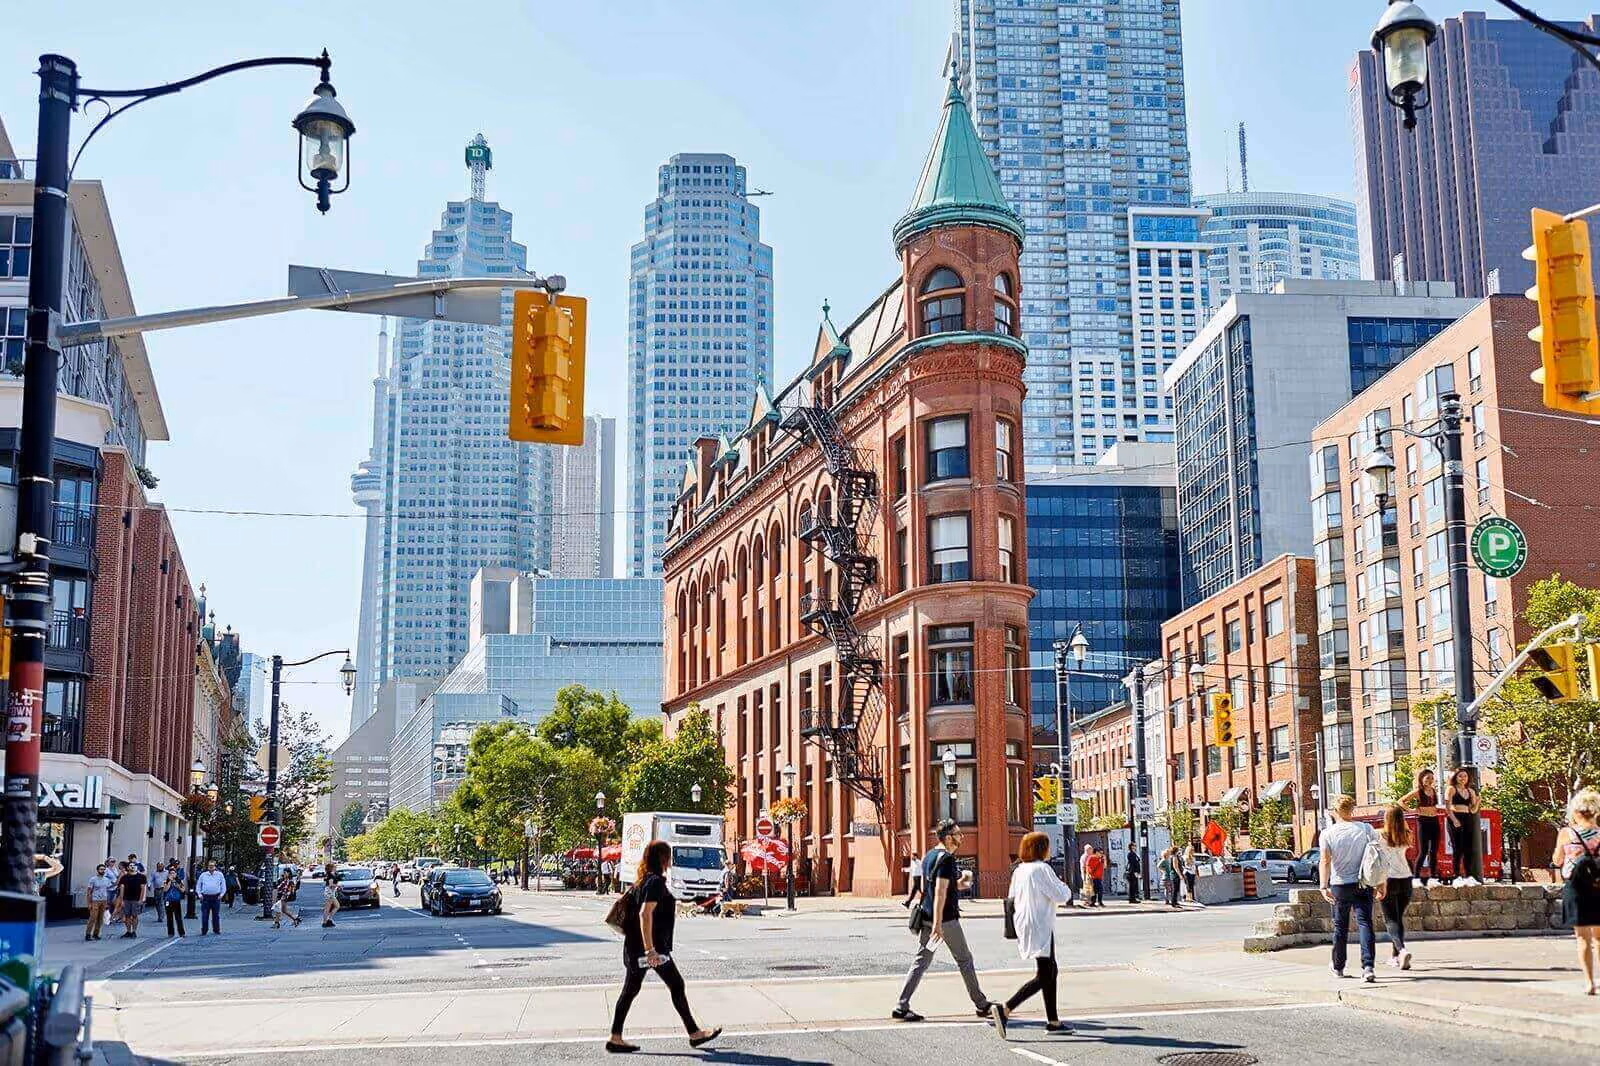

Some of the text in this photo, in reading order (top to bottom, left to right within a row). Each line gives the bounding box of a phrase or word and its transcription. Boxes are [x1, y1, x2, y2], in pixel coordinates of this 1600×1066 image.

[471, 149, 483, 157] TD
[1472, 520, 1523, 546] MUNICIPAL
[1488, 533, 1510, 556] P
[1473, 552, 1523, 576] PARKING
[37, 775, 103, 809] xall
